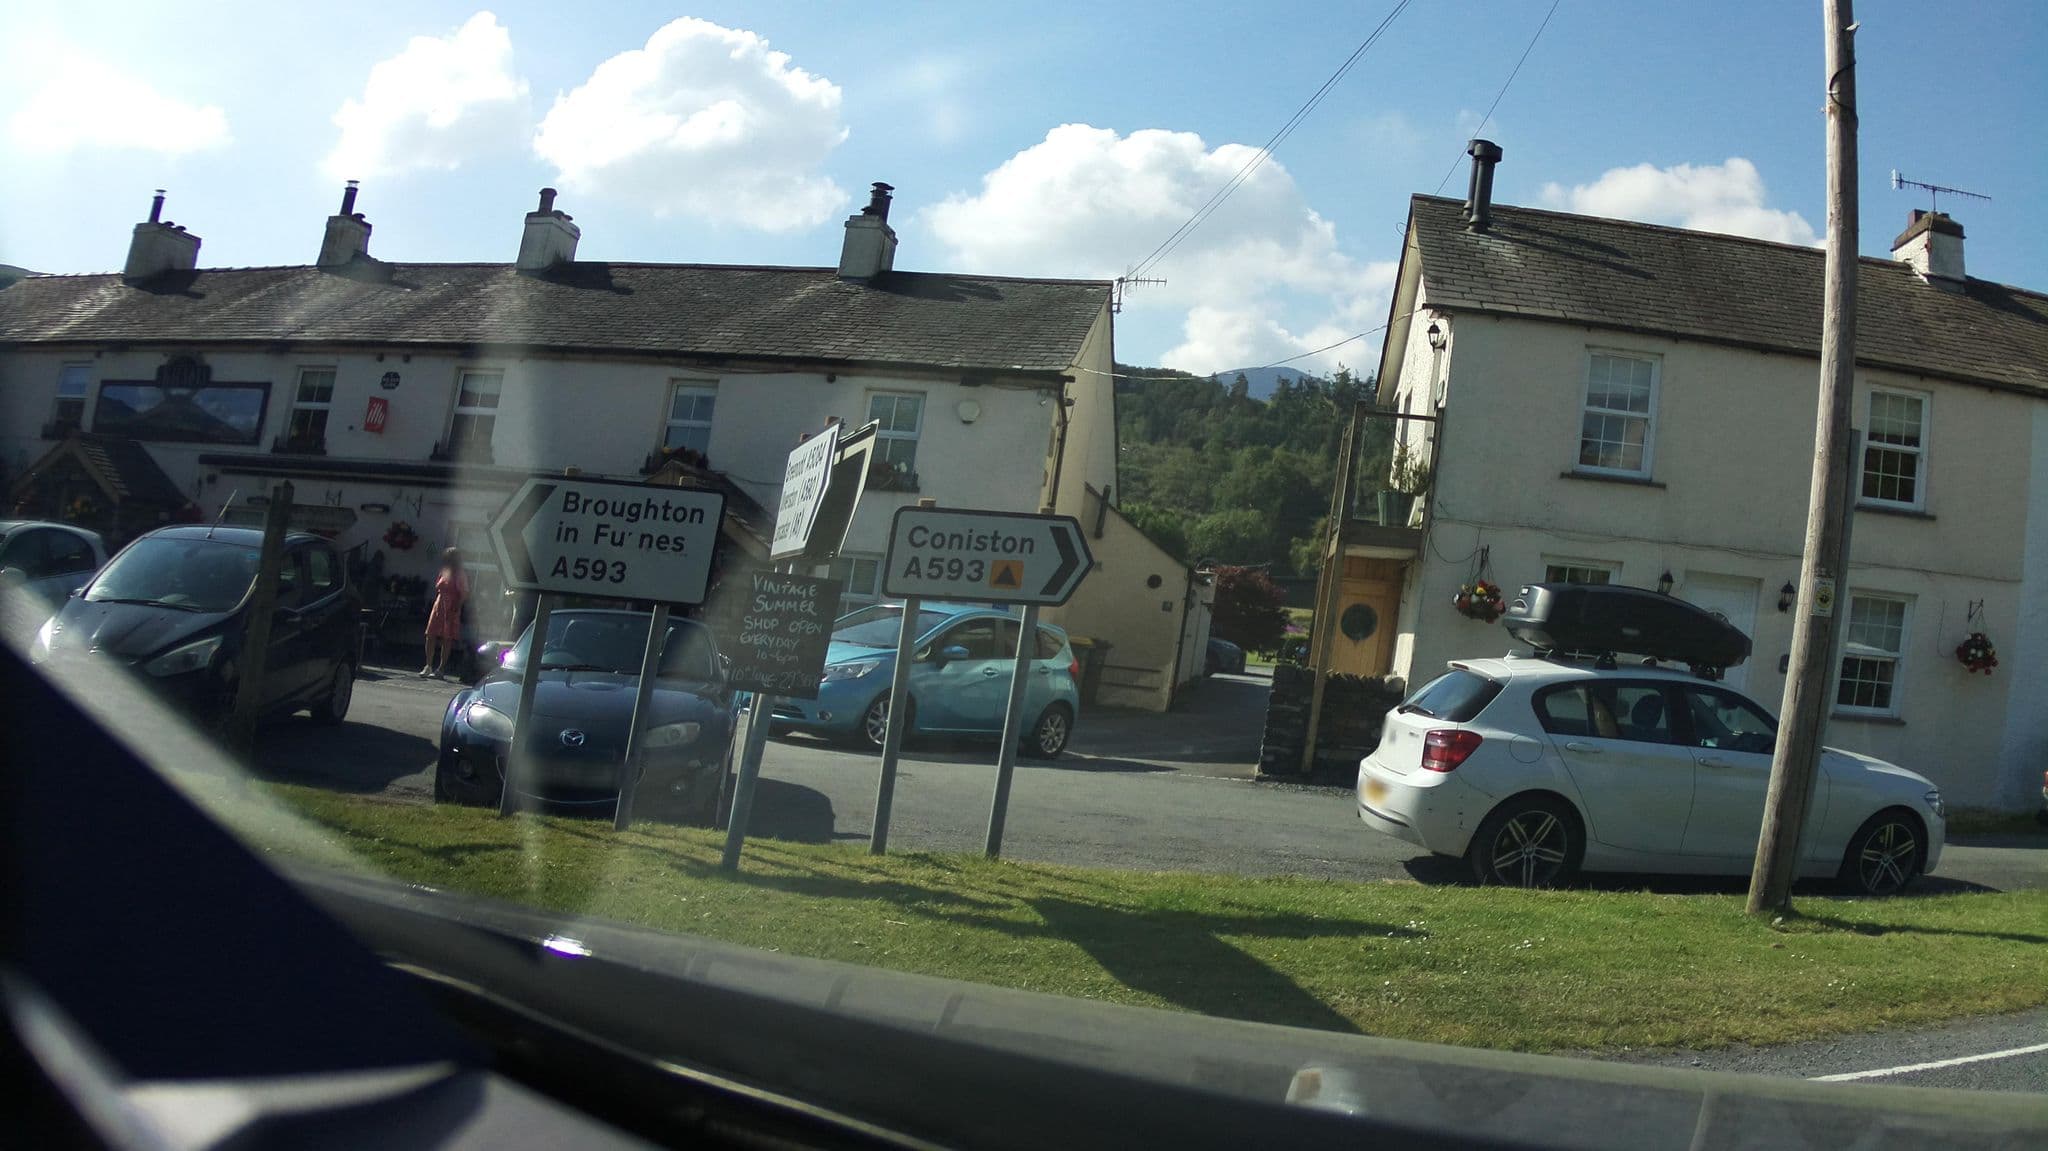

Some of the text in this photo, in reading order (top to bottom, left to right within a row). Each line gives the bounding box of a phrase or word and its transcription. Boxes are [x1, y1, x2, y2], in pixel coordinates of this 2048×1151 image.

[562, 491, 705, 524] Broughton
[556, 521, 685, 552] in Funes
[908, 525, 1034, 554] Coniston
[551, 556, 627, 584] A593
[903, 556, 984, 582] A593
[753, 574, 817, 598] VINTAGE
[752, 594, 818, 616] SUMMER
[743, 615, 823, 635] SHOP OPEN
[740, 632, 801, 651] EVERYDAY
